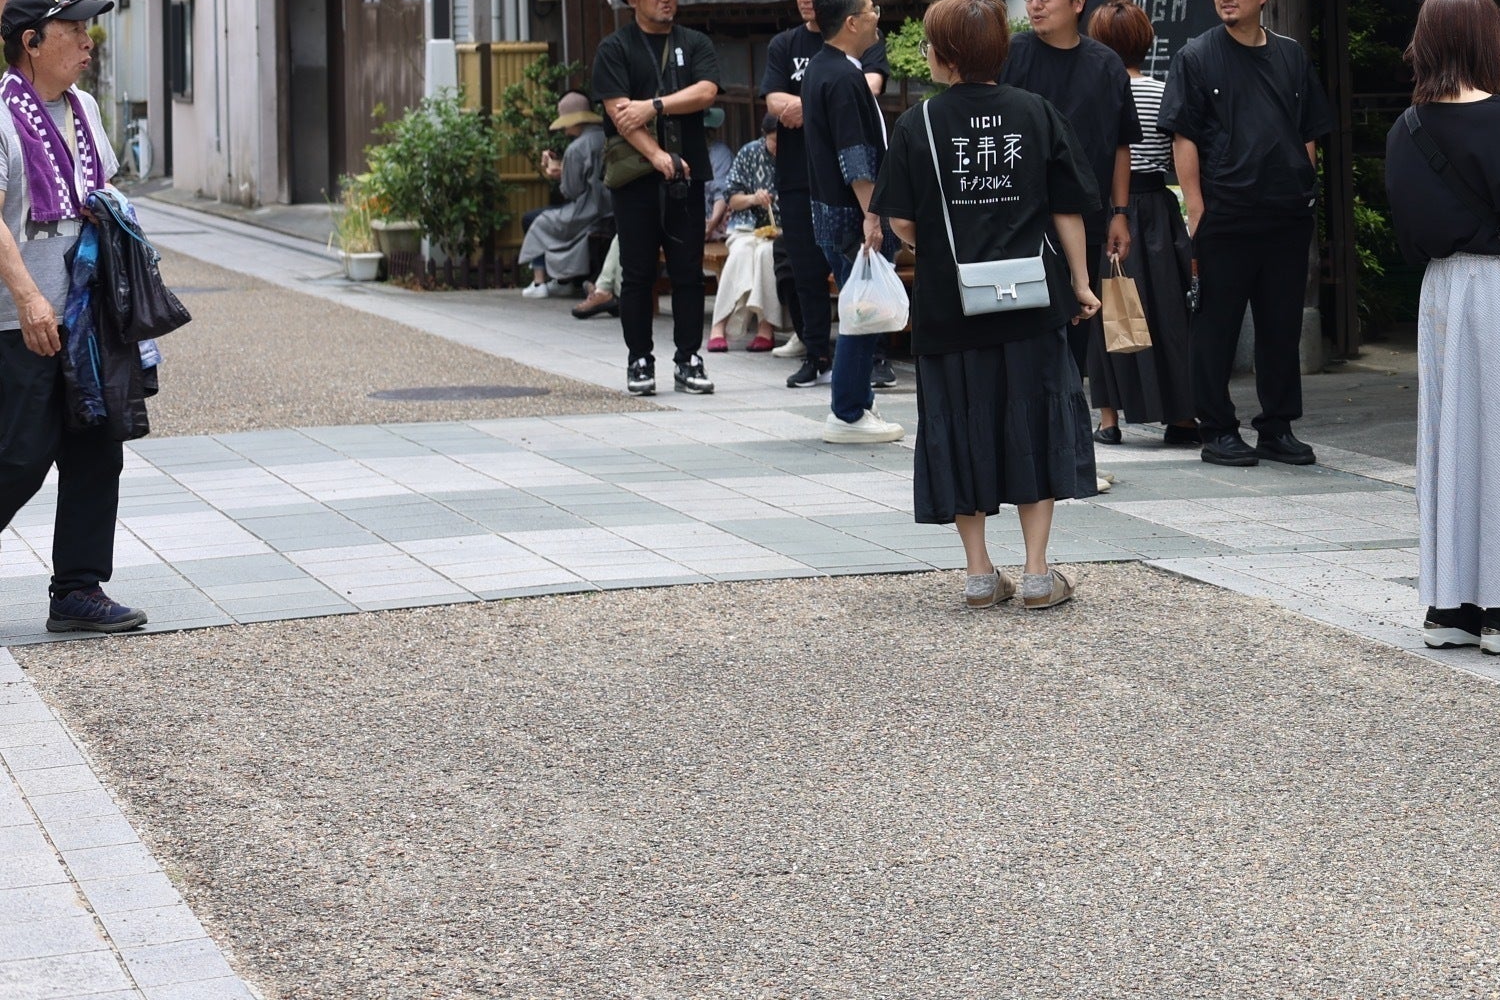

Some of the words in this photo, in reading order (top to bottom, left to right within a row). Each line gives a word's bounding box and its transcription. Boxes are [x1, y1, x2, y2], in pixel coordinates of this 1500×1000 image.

[951, 133, 1022, 174] 宝来家
[960, 174, 1013, 192] ガーデンマルシェ
